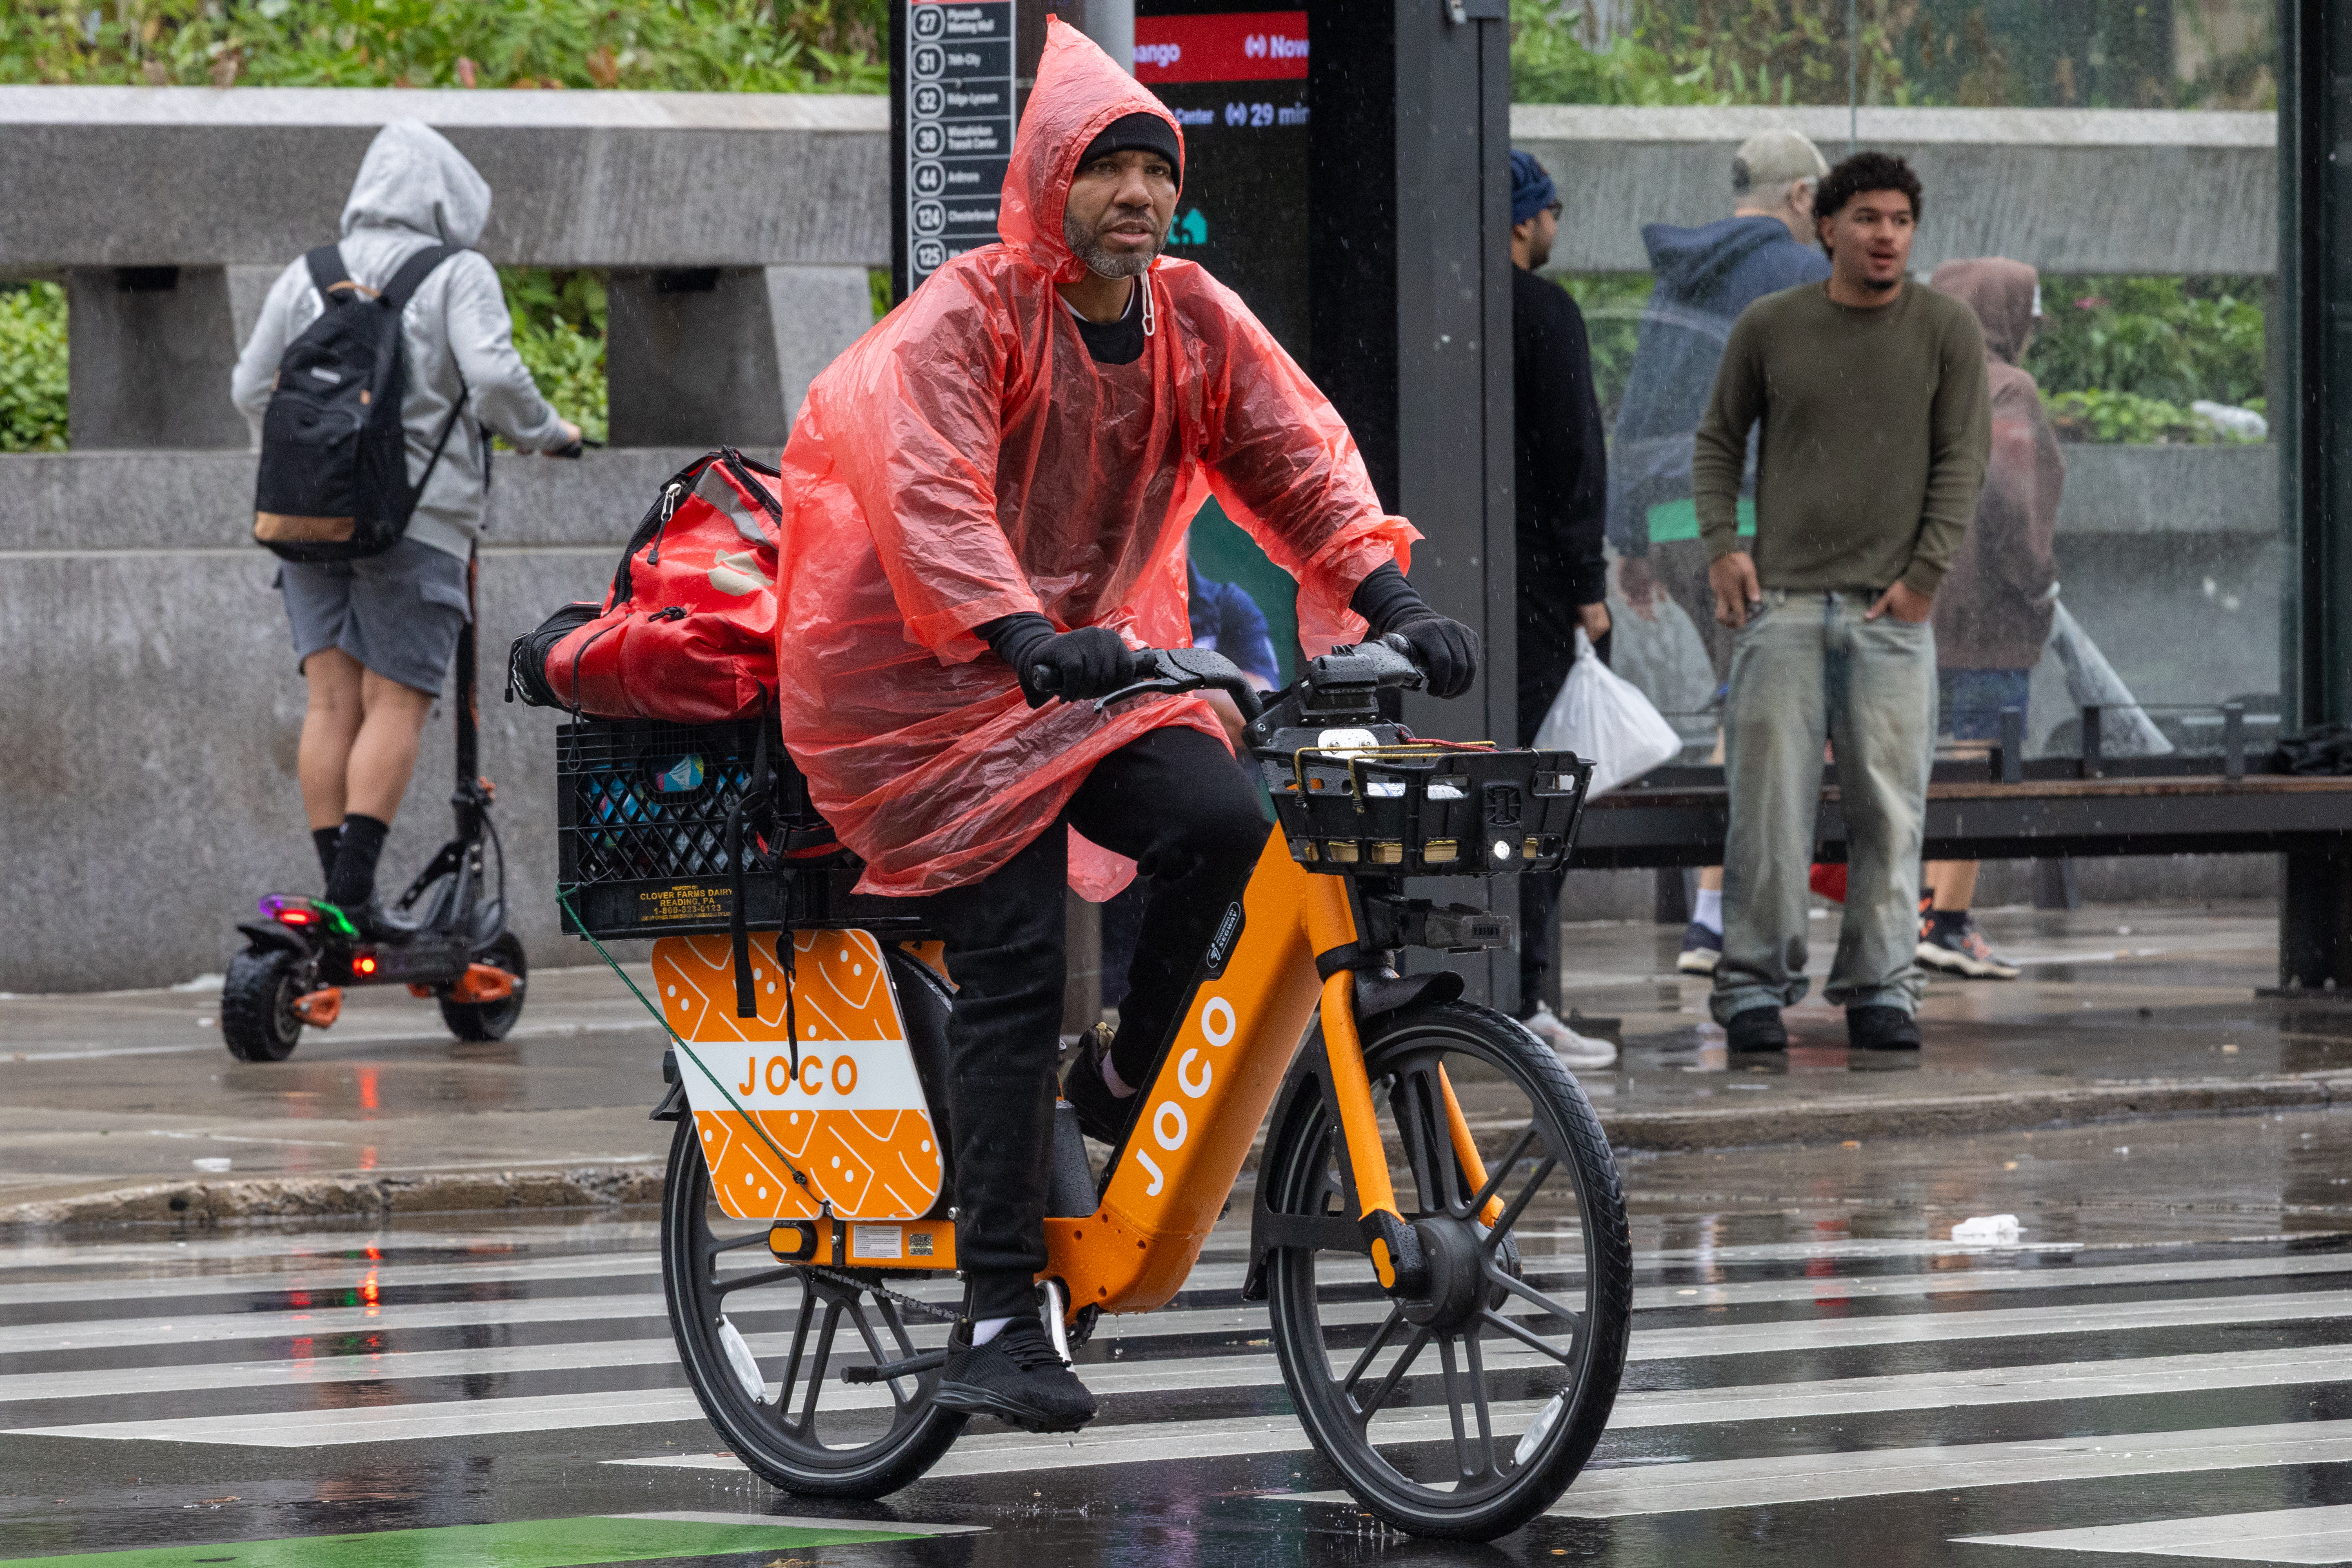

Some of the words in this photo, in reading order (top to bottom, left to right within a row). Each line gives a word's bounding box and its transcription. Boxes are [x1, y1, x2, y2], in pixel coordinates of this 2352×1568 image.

[919, 13, 937, 32] 27
[1270, 35, 1310, 58] Now
[919, 53, 935, 71] 31
[919, 91, 937, 110] 32
[1250, 103, 1274, 127] 29
[1278, 102, 1310, 125] min
[919, 169, 937, 188] 44
[918, 208, 941, 228] 124
[918, 247, 941, 266] 125
[640, 892, 674, 900] CLOVER
[677, 890, 705, 898] FARMS
[708, 888, 732, 896] DAIRY
[660, 898, 700, 907] READING,
[654, 904, 721, 915] 1-800-323-0123
[1216, 917, 1230, 944] POWERED
[1229, 907, 1234, 916] BY
[1219, 911, 1237, 948] SEGWAY
[738, 1054, 858, 1096] JOCO
[1136, 996, 1236, 1197] JOCO
